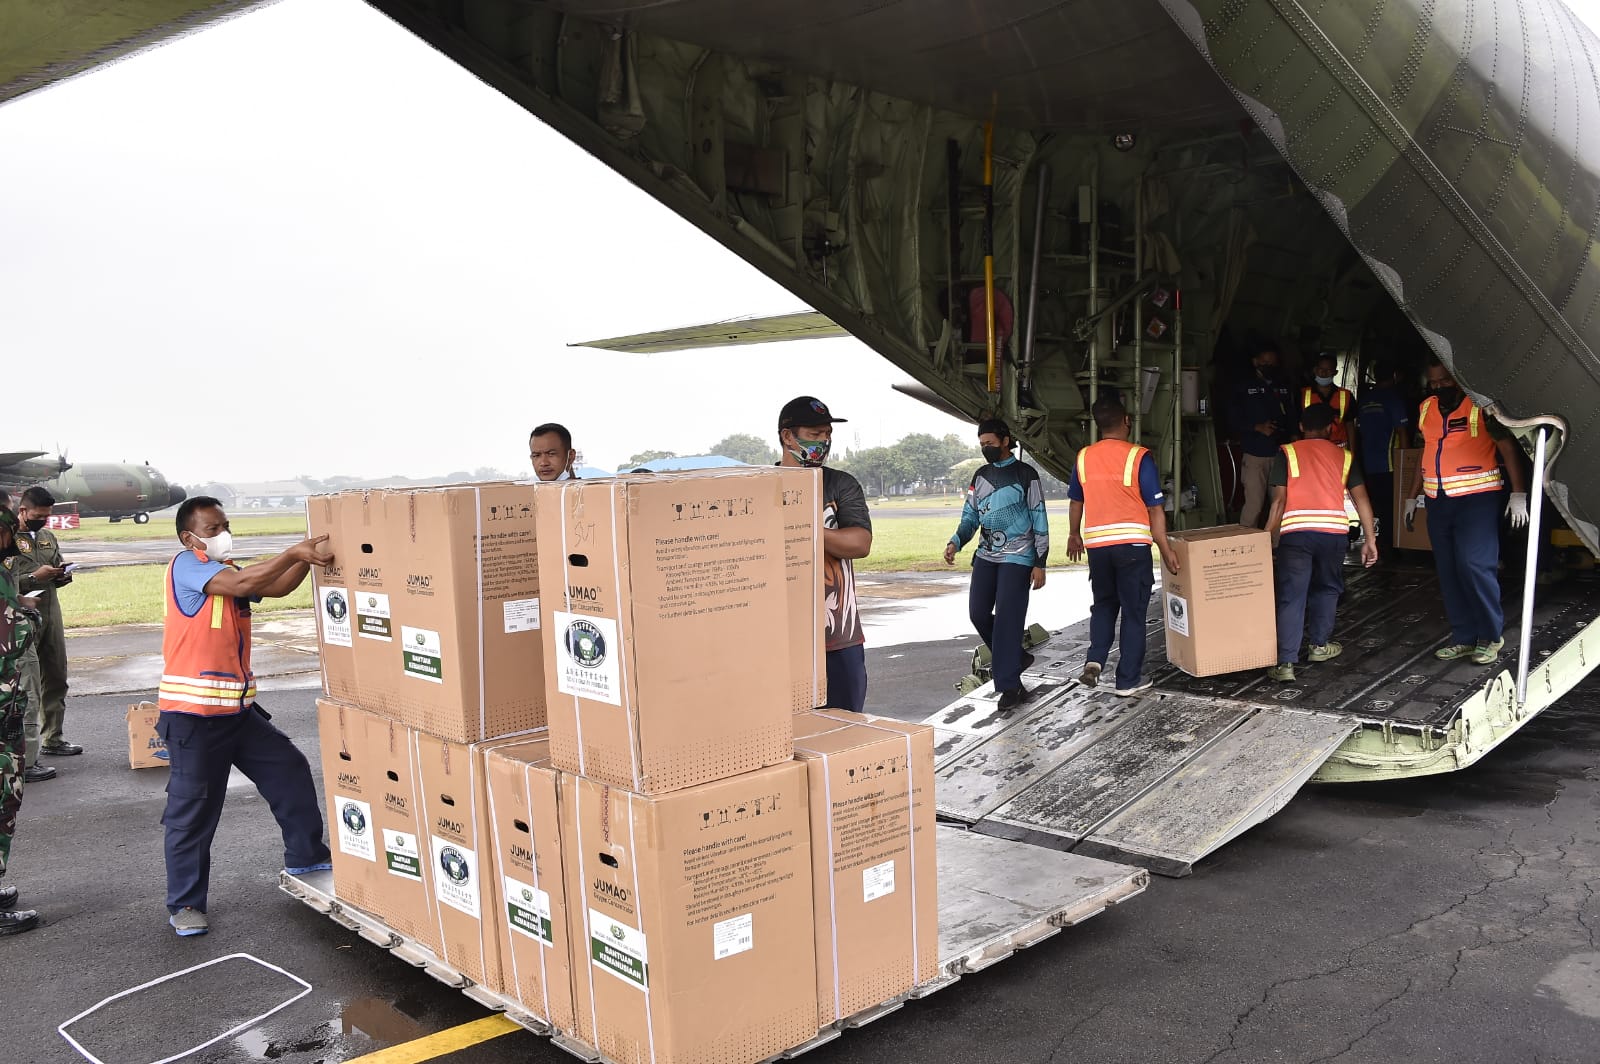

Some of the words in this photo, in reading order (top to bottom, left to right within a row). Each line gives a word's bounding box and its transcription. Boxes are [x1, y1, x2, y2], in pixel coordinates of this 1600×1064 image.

[655, 537, 673, 545] Please
[674, 535, 693, 543] handle
[406, 574, 430, 587] JUMAO
[437, 816, 461, 834] JUMAO
[683, 847, 700, 856] Please
[701, 842, 720, 851] handle
[733, 834, 746, 842] care!
[593, 877, 628, 901] JUMAO
[598, 951, 642, 980] KEMANUSIAAN
[604, 945, 633, 967] BANTUAN
